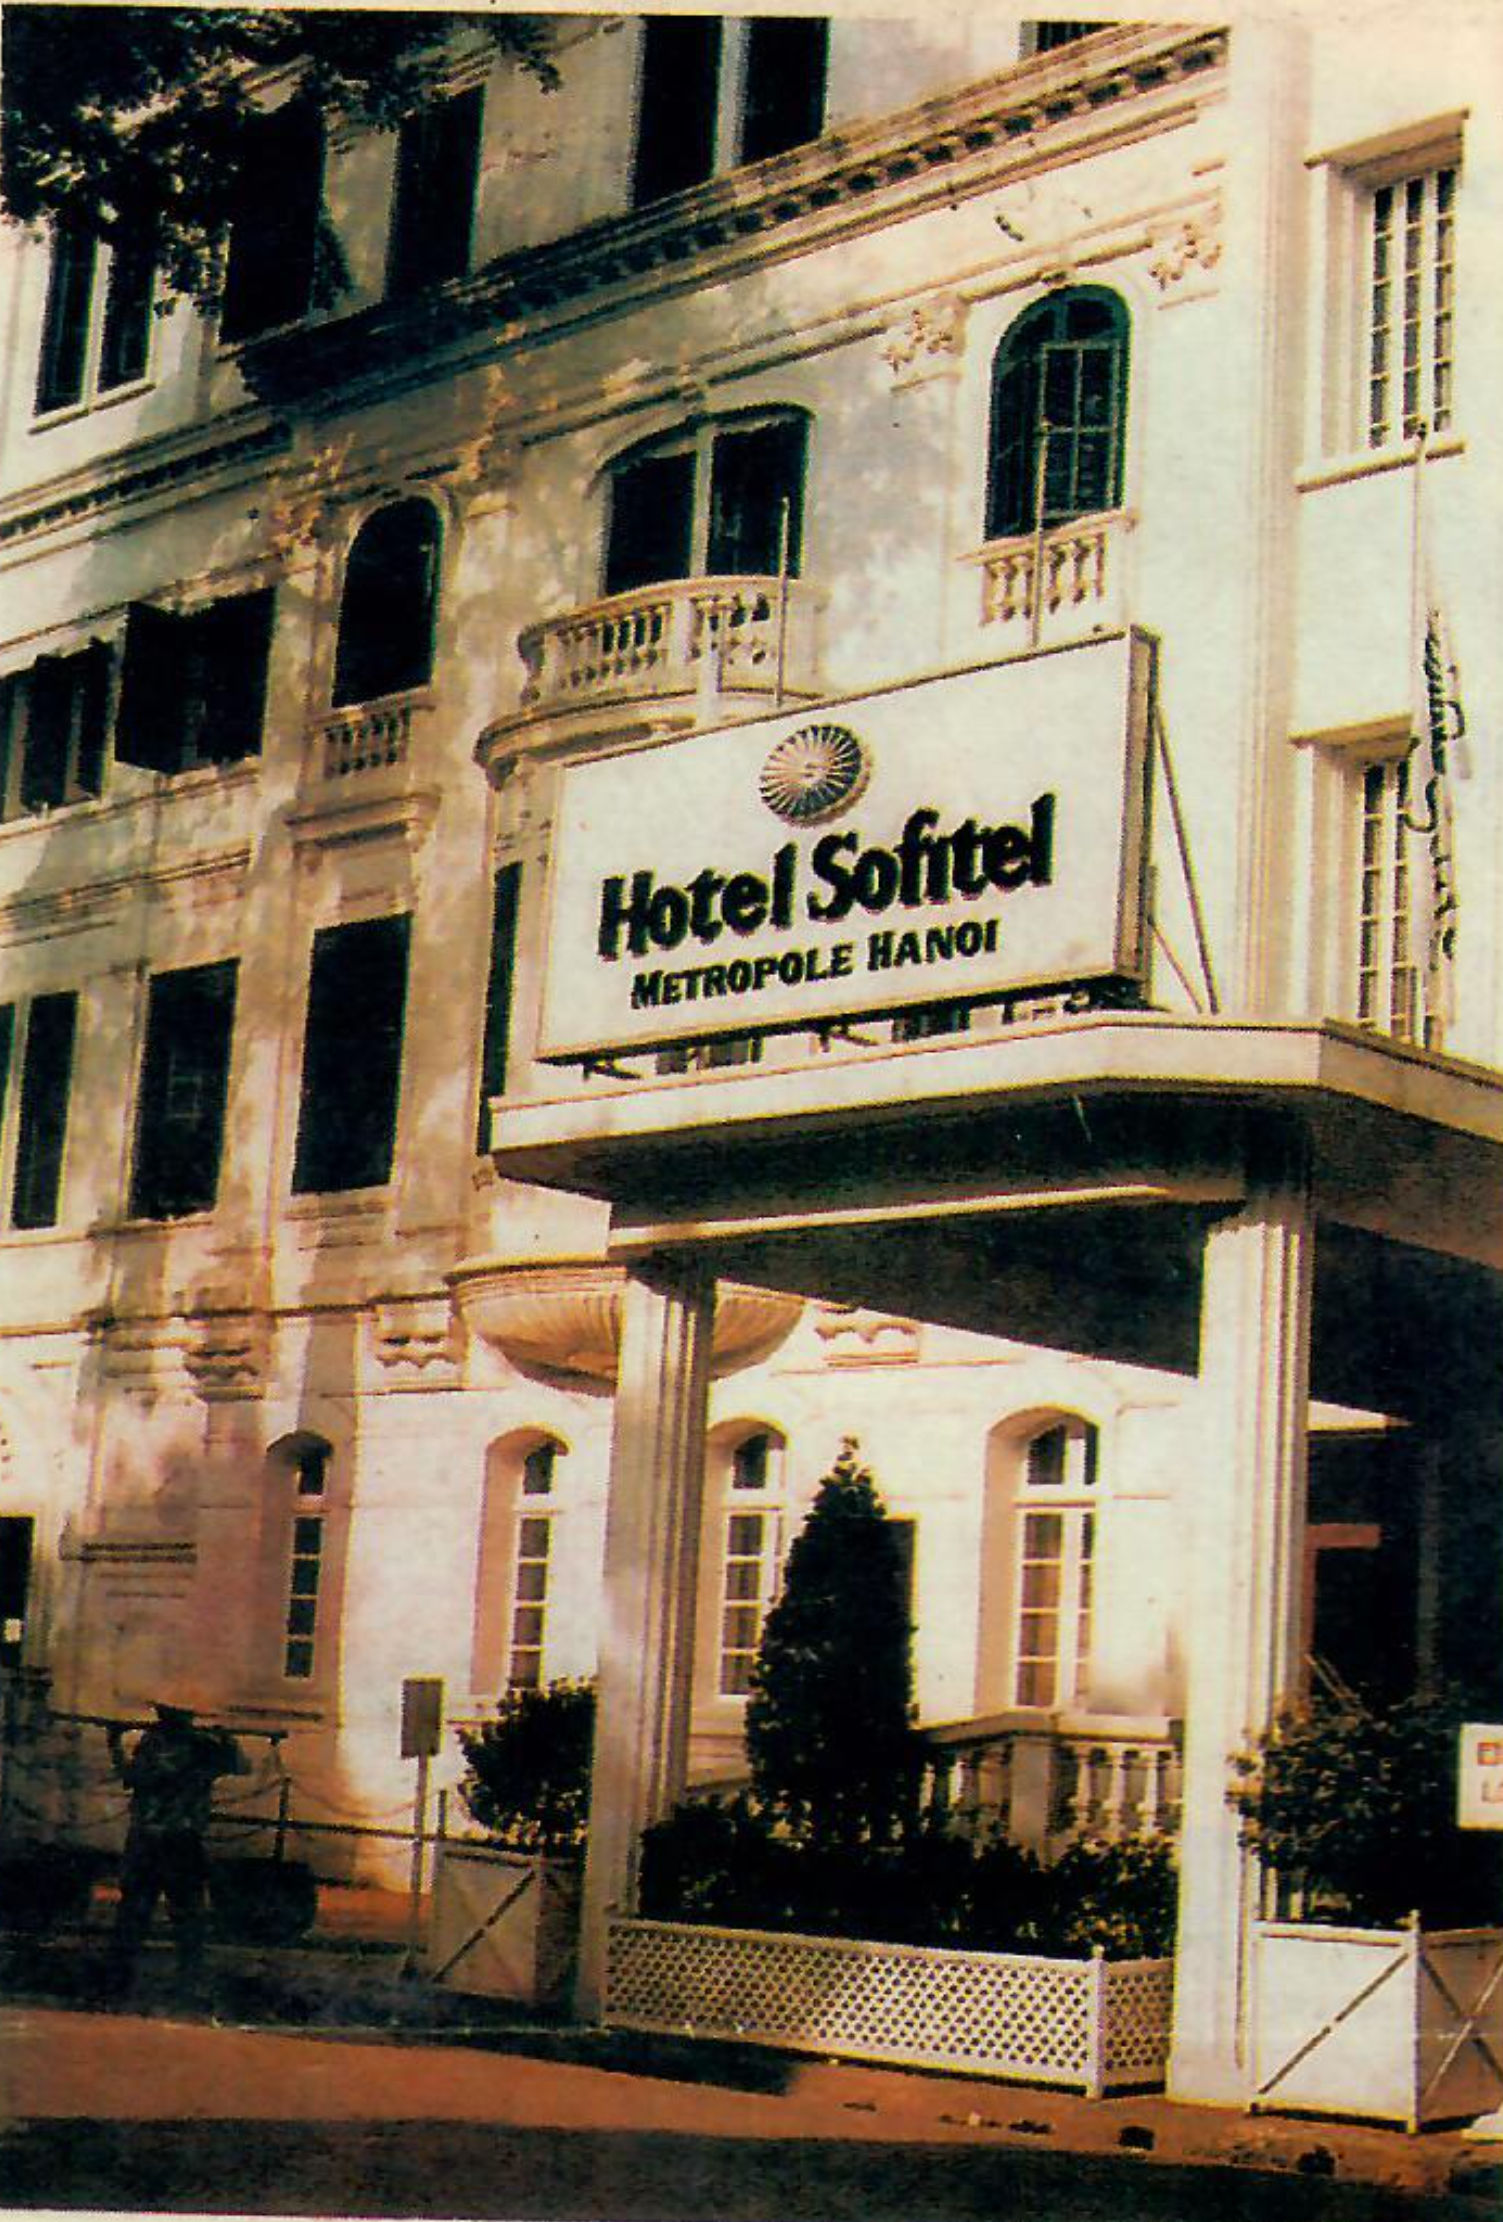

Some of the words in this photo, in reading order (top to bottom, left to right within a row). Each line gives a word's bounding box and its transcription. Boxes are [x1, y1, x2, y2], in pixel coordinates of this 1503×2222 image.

[598, 842, 798, 961] Hotel
[806, 792, 1056, 923] Sofitel
[631, 943, 854, 1009] METROPOLE
[867, 918, 1000, 971] HANOI
